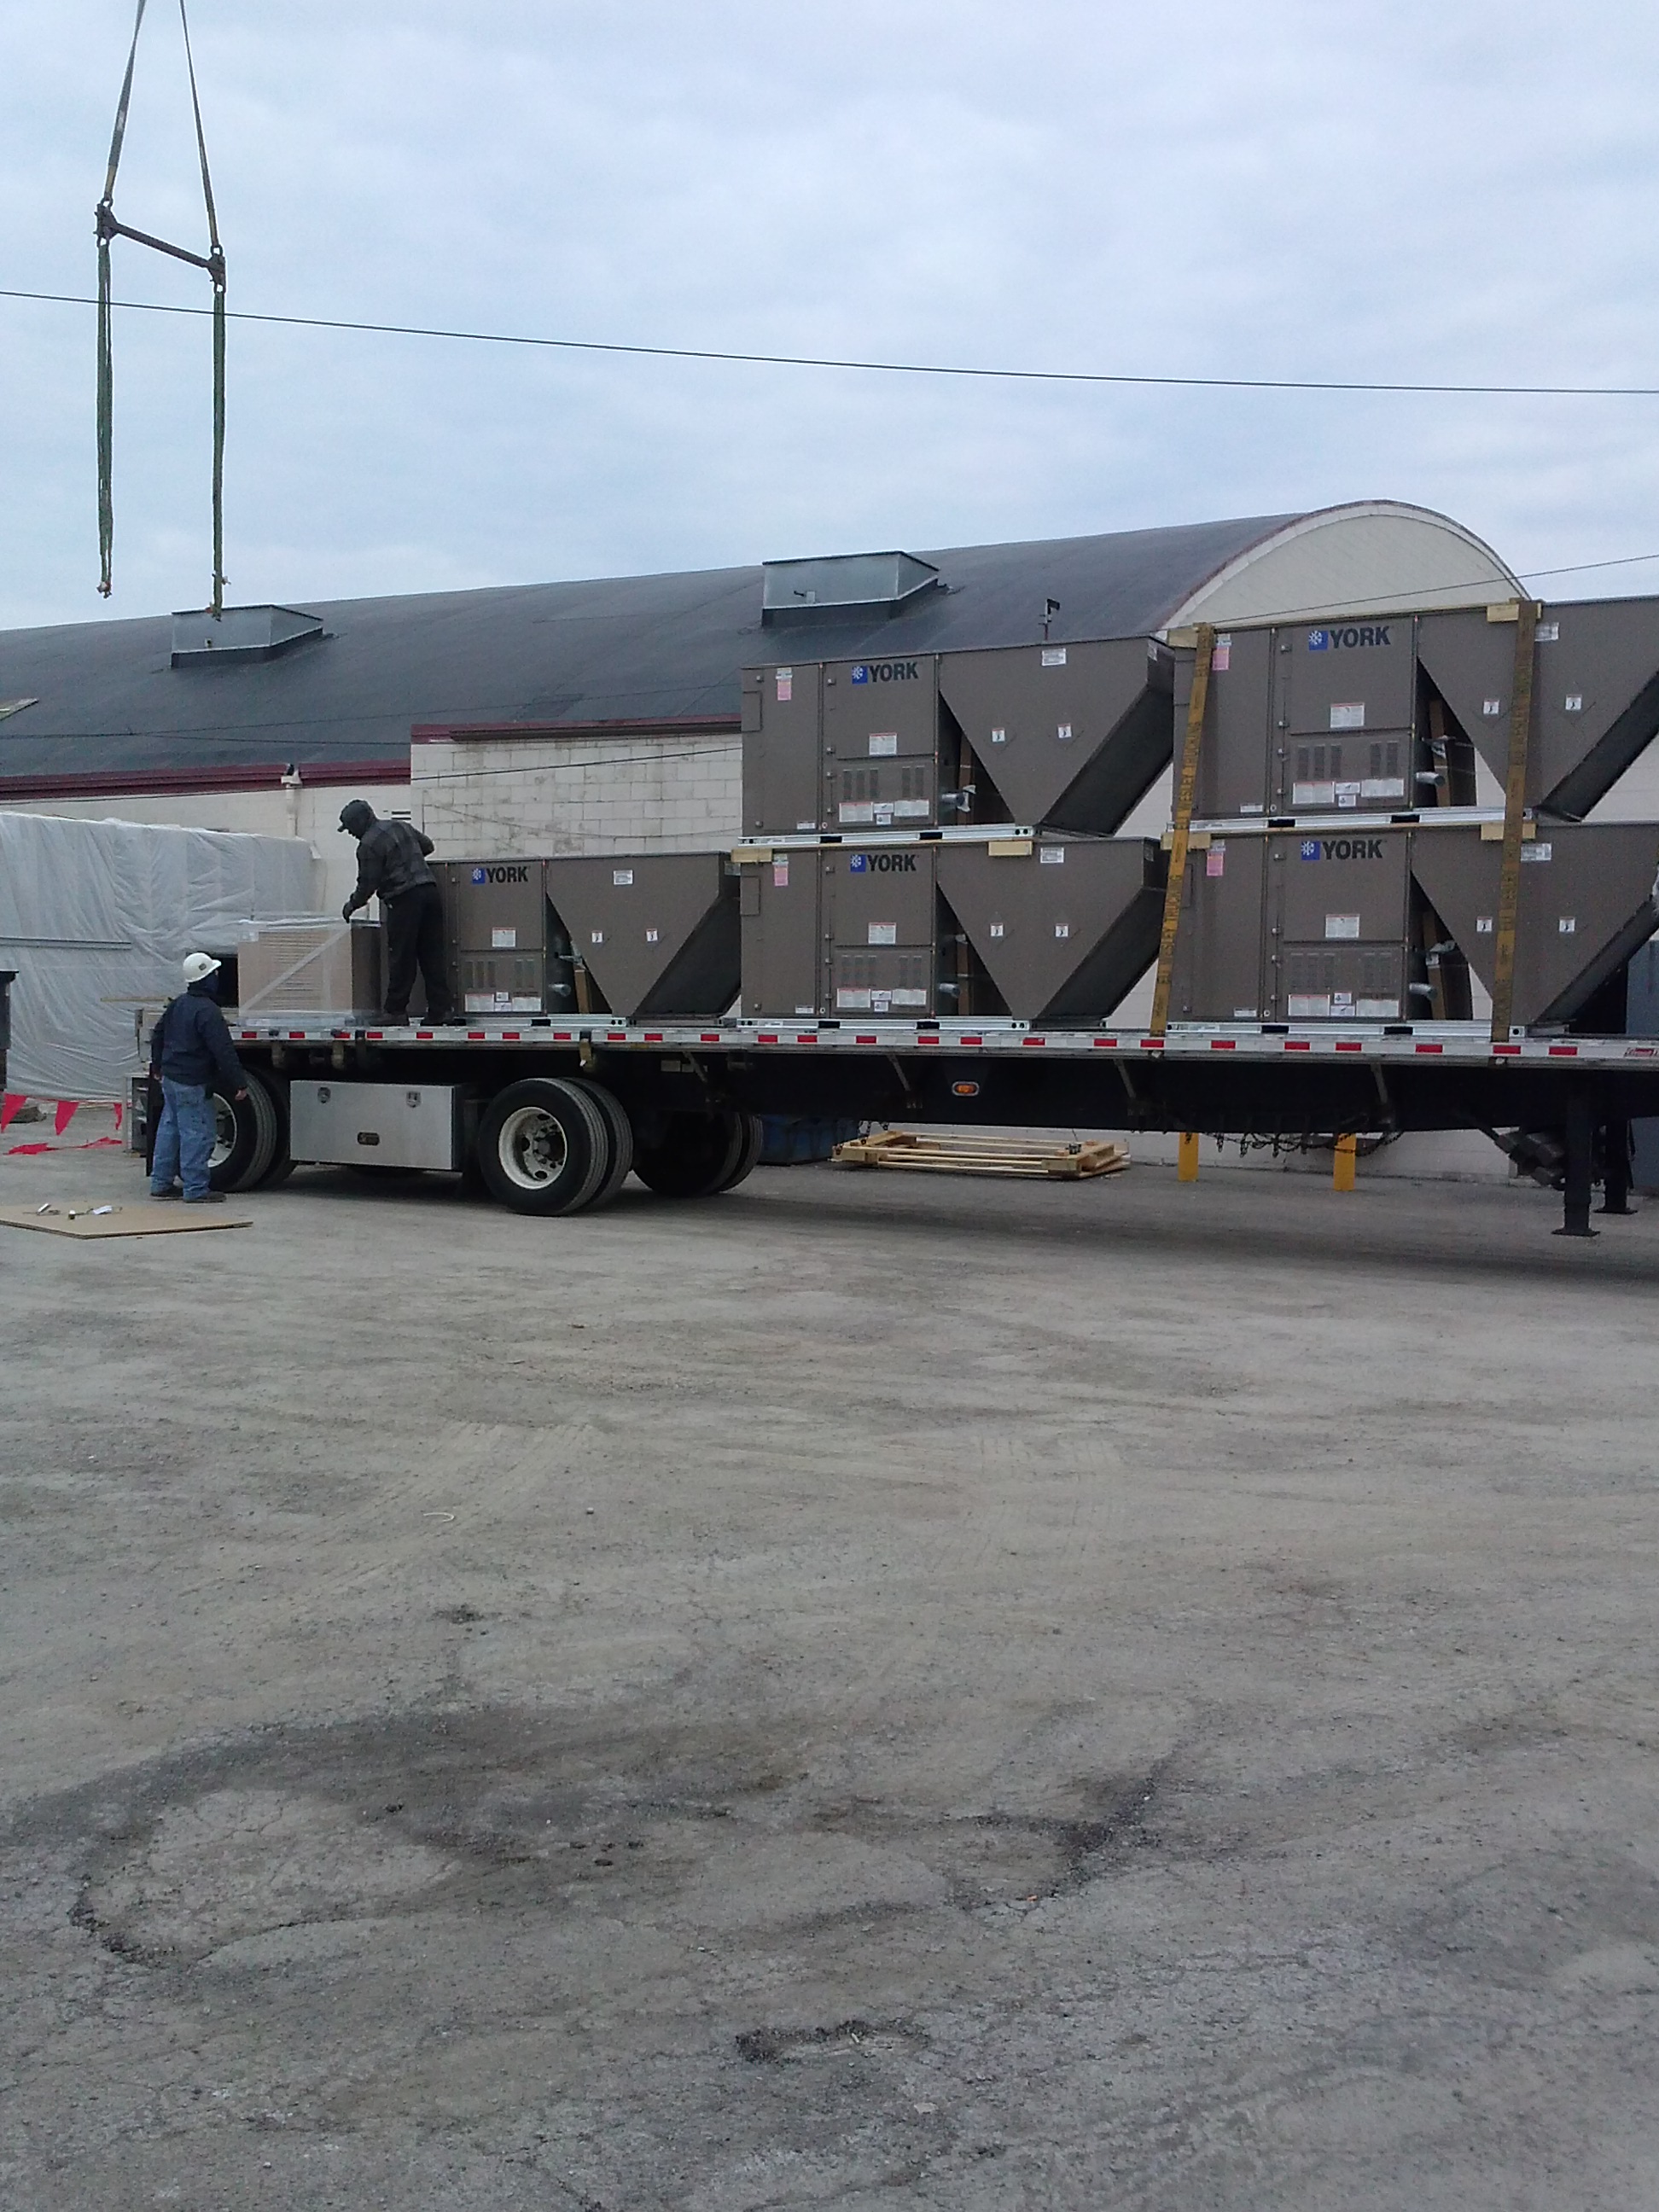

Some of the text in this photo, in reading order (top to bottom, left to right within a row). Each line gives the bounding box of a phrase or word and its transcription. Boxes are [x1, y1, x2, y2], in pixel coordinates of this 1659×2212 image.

[1330, 626, 1391, 649] YORK
[869, 662, 918, 683] YORK
[1322, 839, 1382, 860] YORK
[867, 854, 917, 872] YORK
[486, 866, 528, 882] YORK
